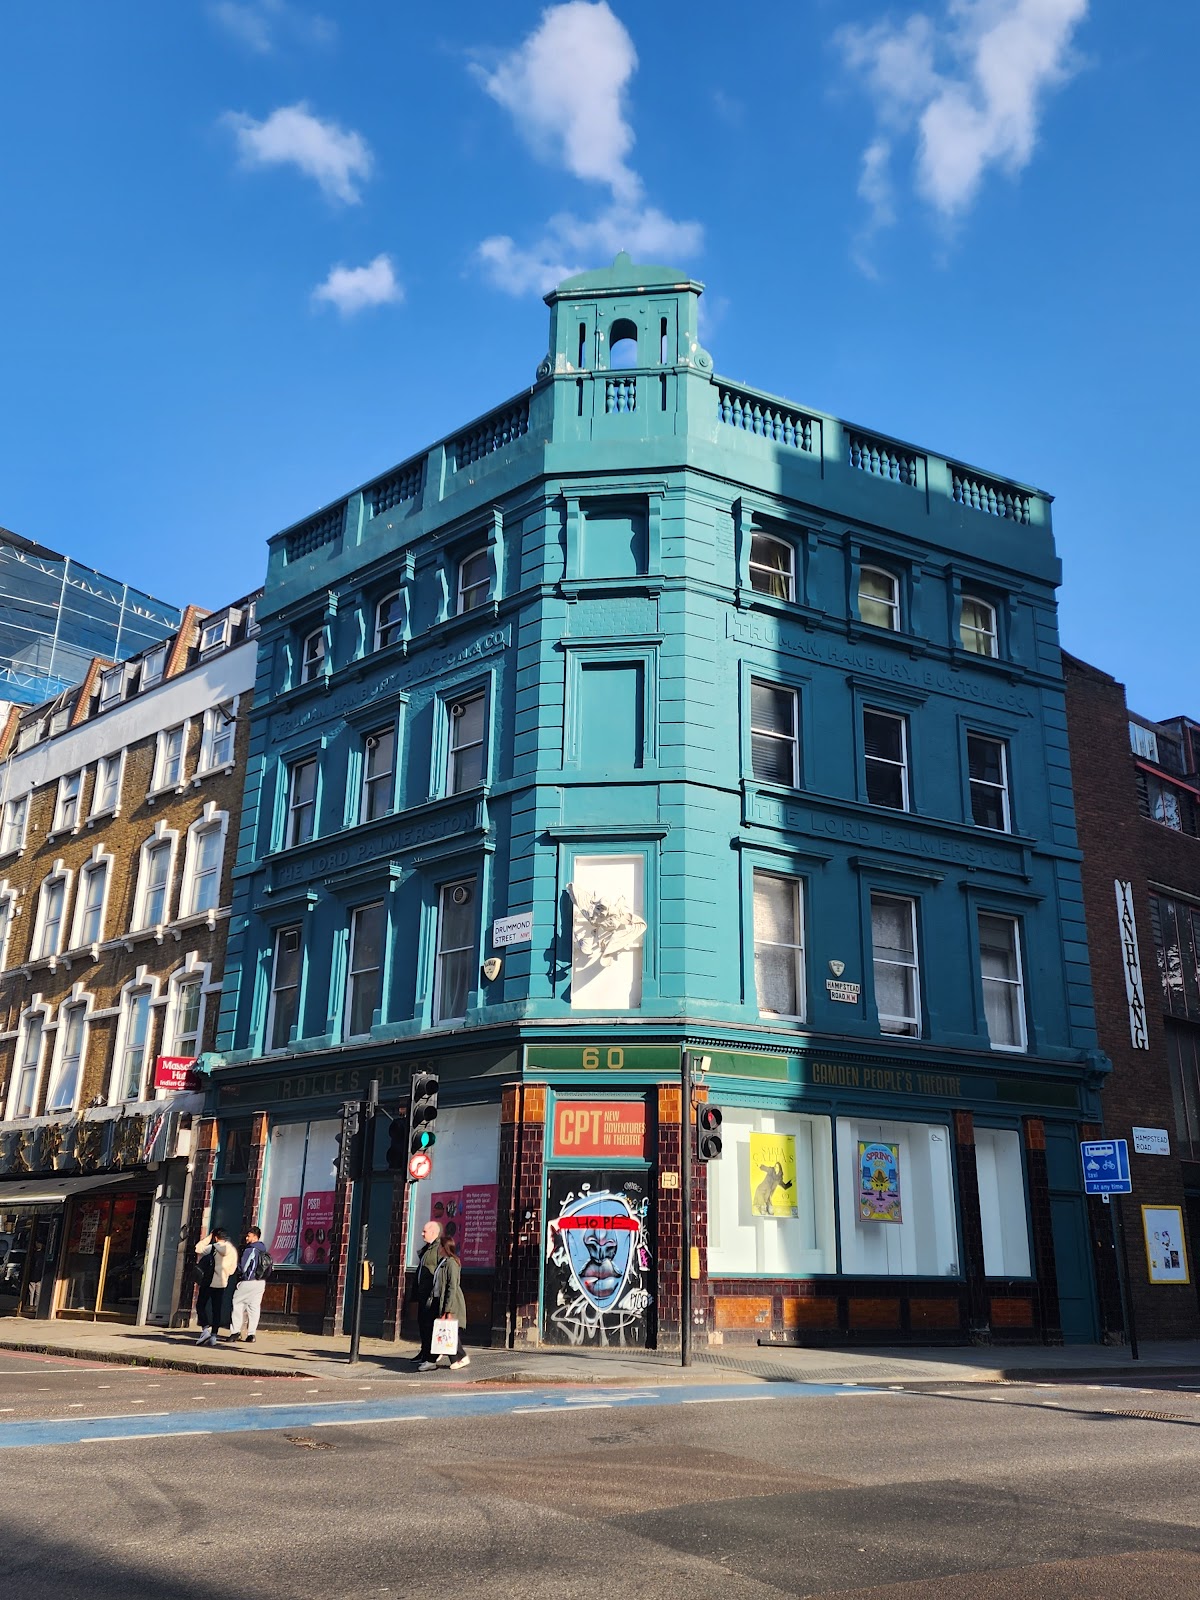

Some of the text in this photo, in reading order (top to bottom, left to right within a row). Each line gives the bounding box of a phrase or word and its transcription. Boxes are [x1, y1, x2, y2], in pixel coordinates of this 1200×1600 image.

[754, 803, 1020, 870] THE LORD PALMERSTON
[277, 810, 476, 884] THE LORD PALMERSTON
[495, 920, 531, 934] DRUMMOND
[495, 933, 516, 944] STREET
[827, 981, 860, 993] HAMPSTEAD
[282, 1060, 434, 1099] ROLLES BROS
[812, 1063, 962, 1096] CAMDEN PEOPLE'S THEATRE
[604, 1111, 620, 1121] NEW
[560, 1109, 602, 1145] CPT
[603, 1122, 646, 1134] ADVENTURES
[603, 1134, 641, 1145] IN THEATRE
[1135, 1134, 1168, 1143] HAMPSTEAD
[1136, 1143, 1152, 1151] ROAD
[866, 1151, 893, 1164] SPRING
[279, 1219, 293, 1233] THIS
[576, 1216, 631, 1229] HOPE
